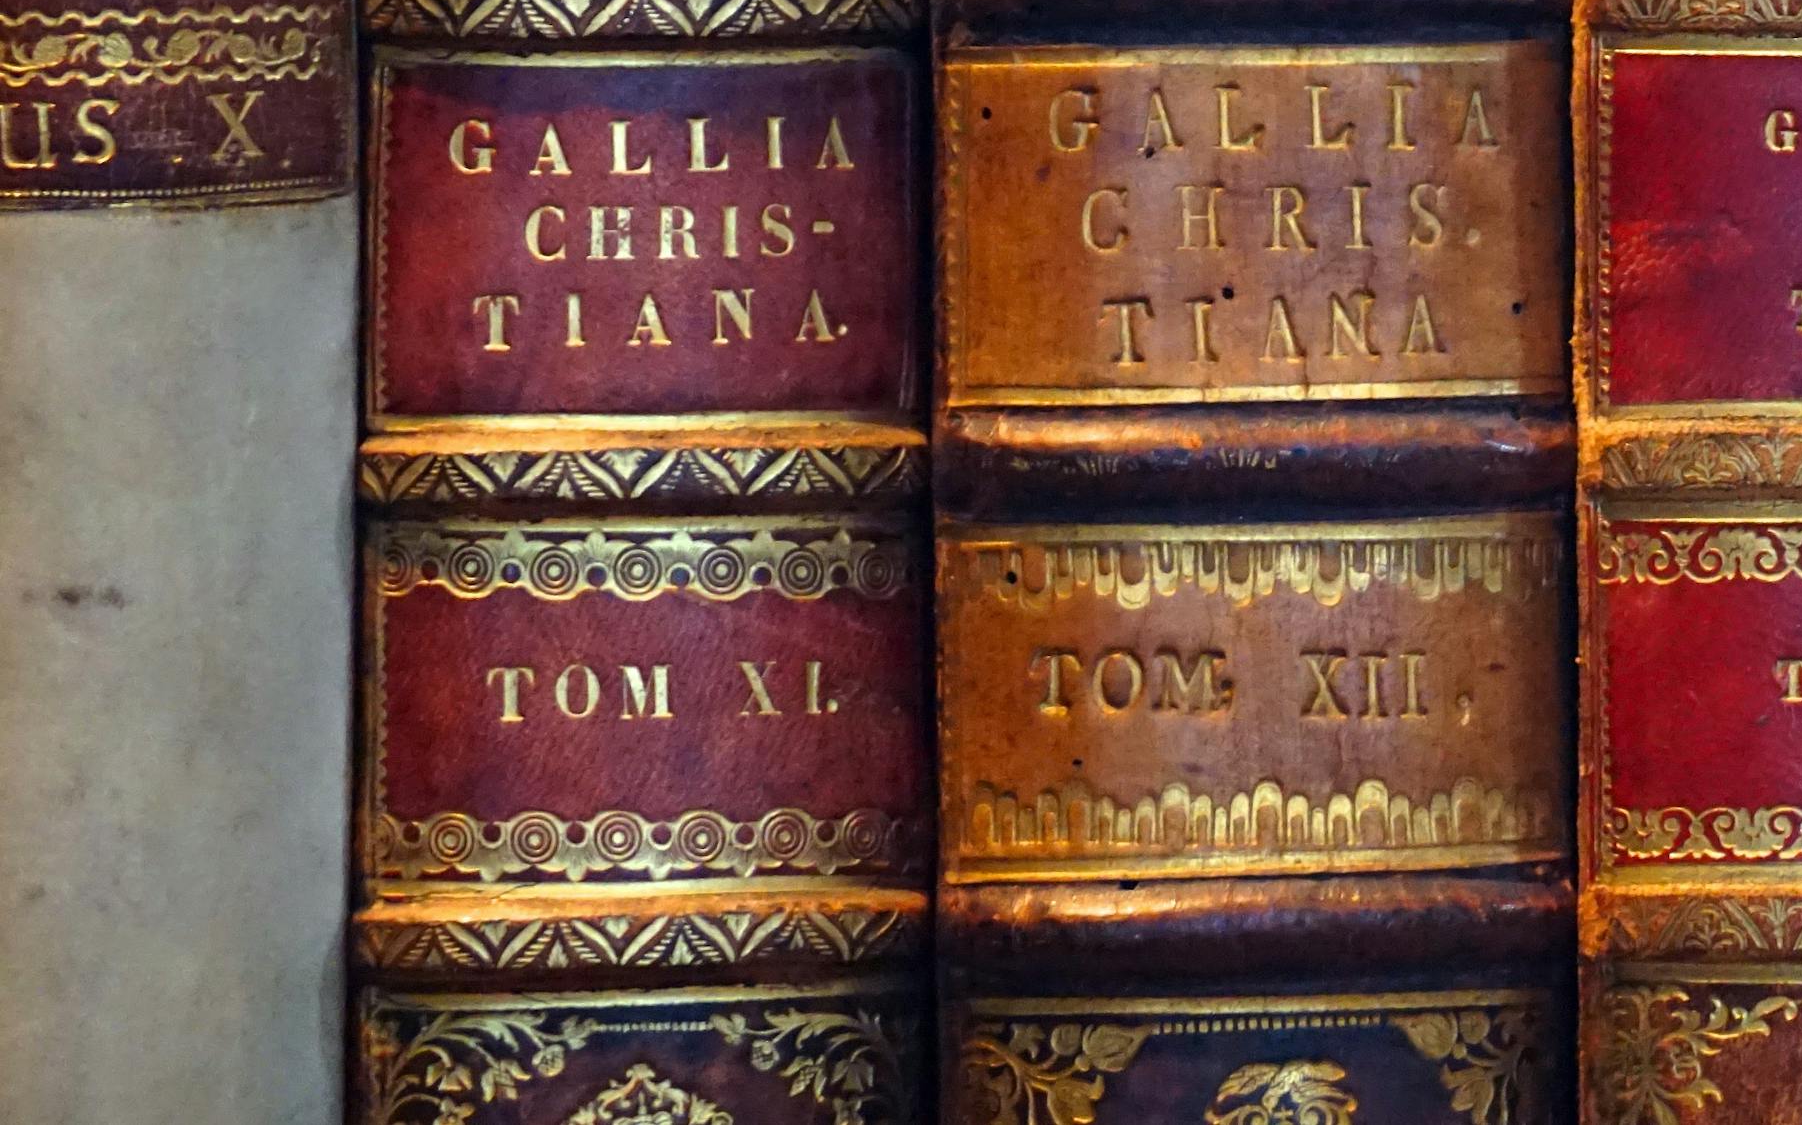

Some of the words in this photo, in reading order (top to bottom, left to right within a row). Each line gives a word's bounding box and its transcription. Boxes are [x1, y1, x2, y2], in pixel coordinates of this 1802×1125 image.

[449, 116, 855, 175] GALLIA
[1049, 81, 1498, 153] GALLIA
[524, 204, 836, 261] CHRIS-
[1081, 181, 1482, 253] CHRIS.
[472, 288, 850, 352] TIANA.
[1098, 293, 1446, 367] TIANA
[486, 662, 674, 723] TOM
[738, 660, 840, 716] XI.
